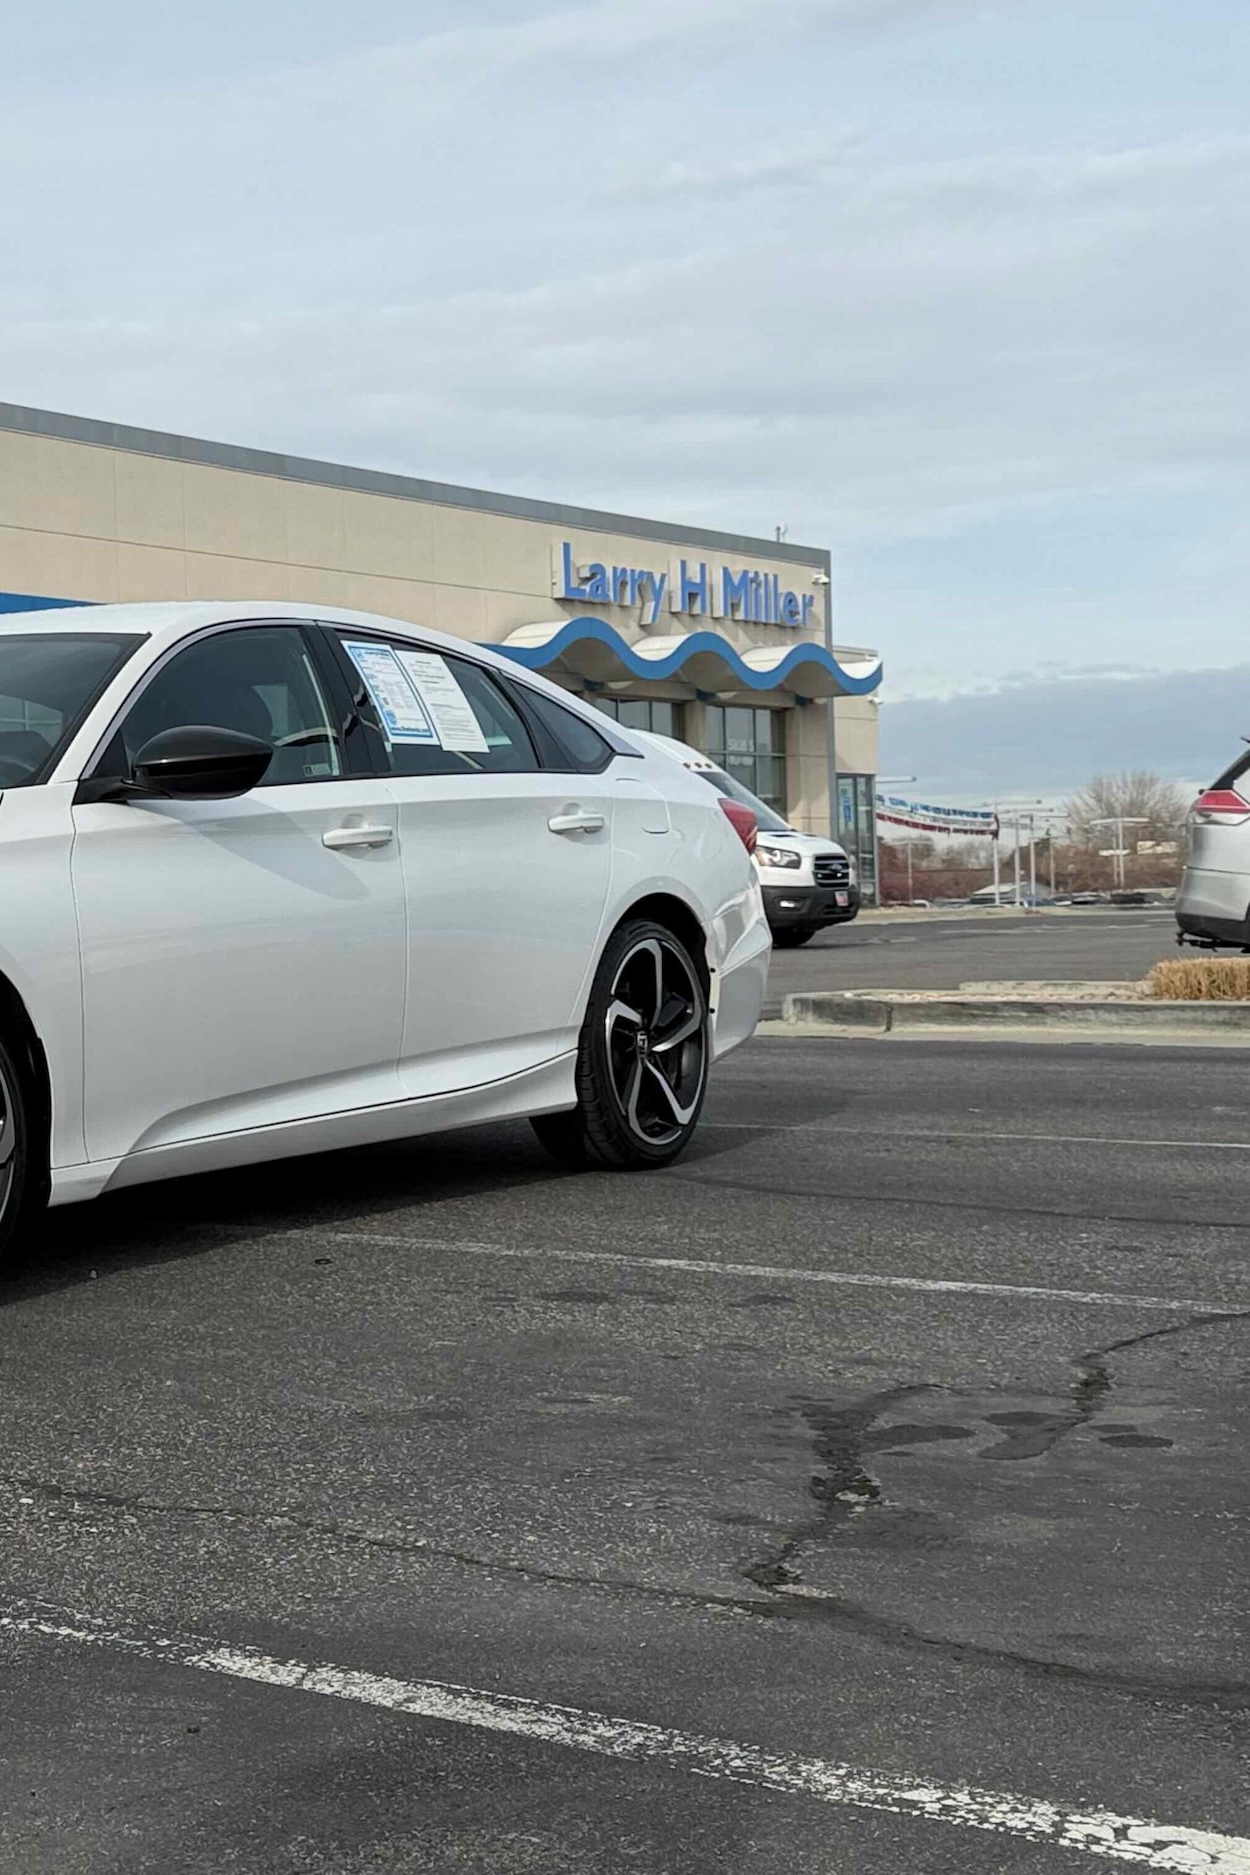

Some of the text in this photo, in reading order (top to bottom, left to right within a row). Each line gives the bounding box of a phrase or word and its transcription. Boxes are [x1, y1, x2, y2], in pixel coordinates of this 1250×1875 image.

[559, 541, 815, 627] Larry H Miller
